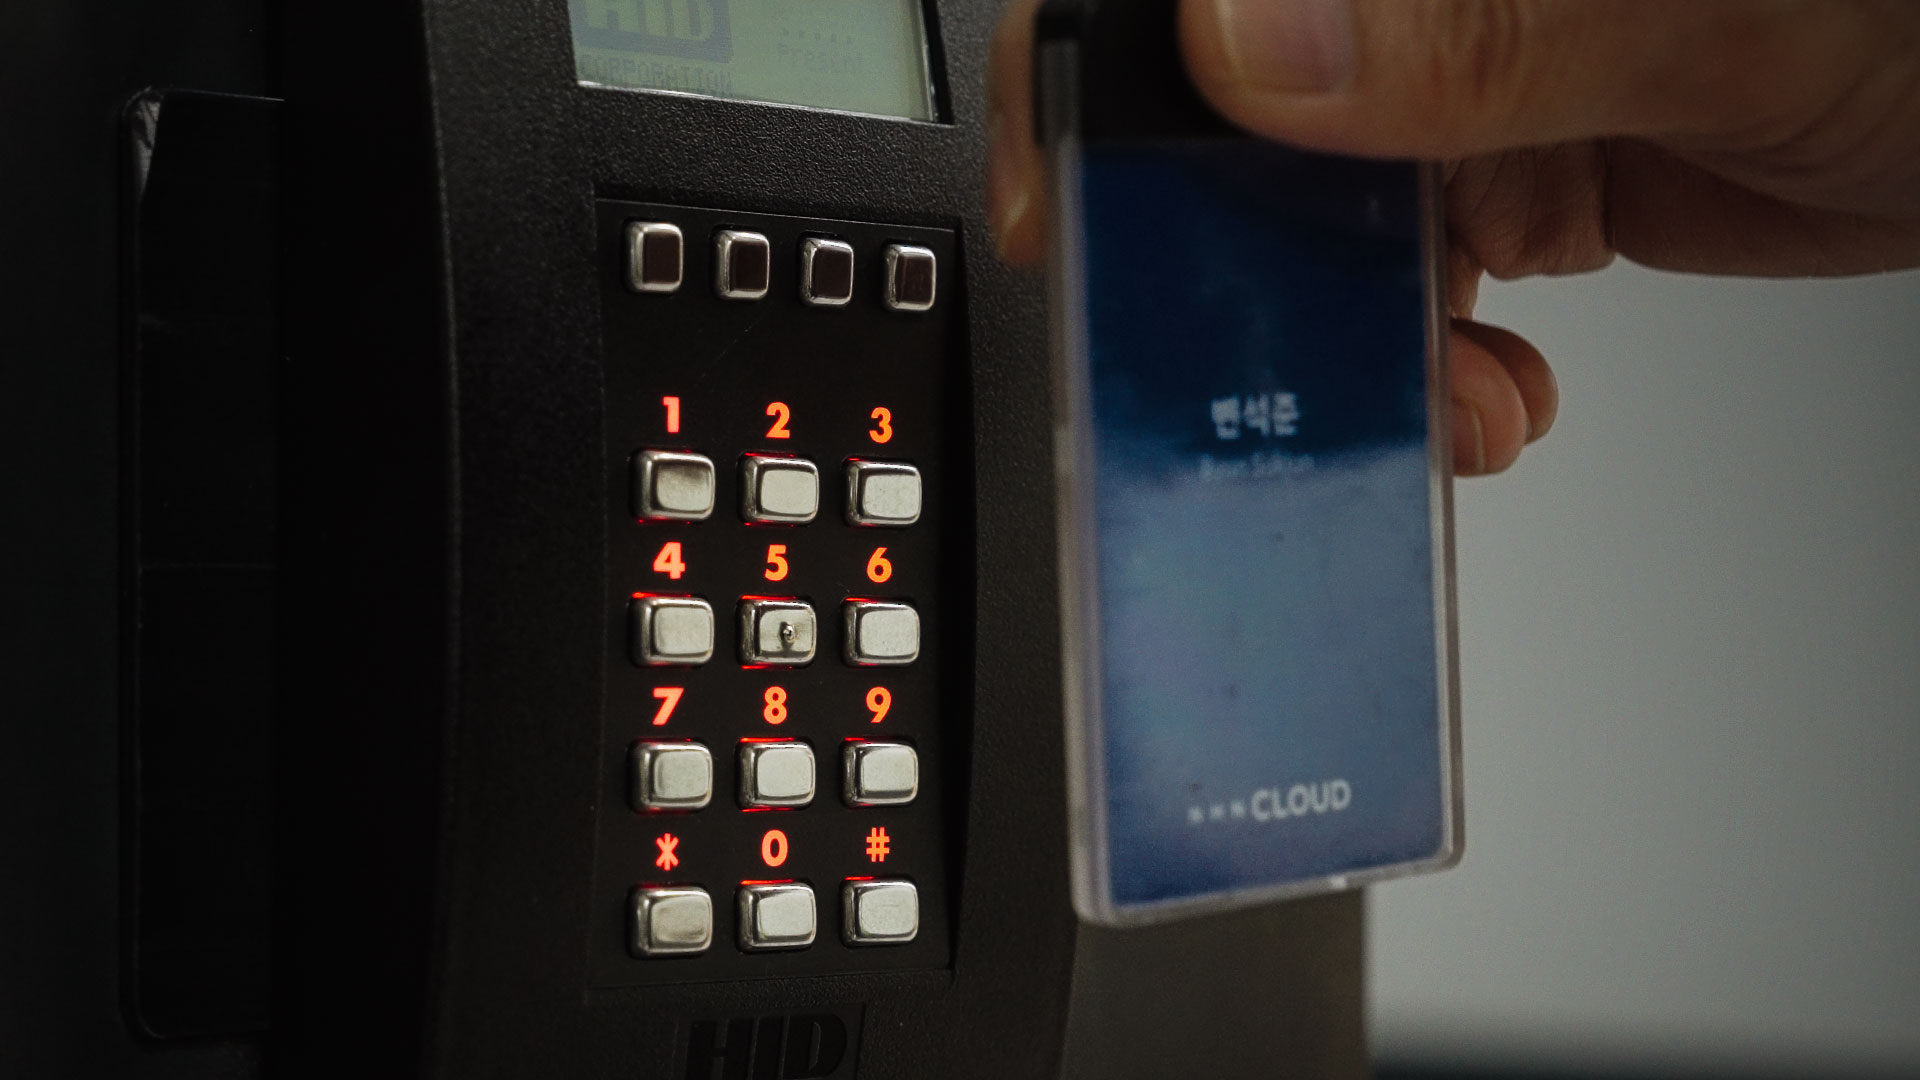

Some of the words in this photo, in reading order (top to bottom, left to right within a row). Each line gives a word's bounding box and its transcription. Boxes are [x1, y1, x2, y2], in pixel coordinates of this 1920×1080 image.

[662, 396, 681, 433] 1
[765, 402, 791, 439] 2
[868, 407, 893, 443] 3
[653, 541, 686, 579] 4
[764, 544, 789, 581] 5
[866, 547, 892, 583] 6
[652, 687, 685, 726] 7
[763, 686, 788, 725] 8
[865, 686, 892, 723] 9
[761, 829, 789, 867] 0
[686, 1016, 847, 1080] HID
